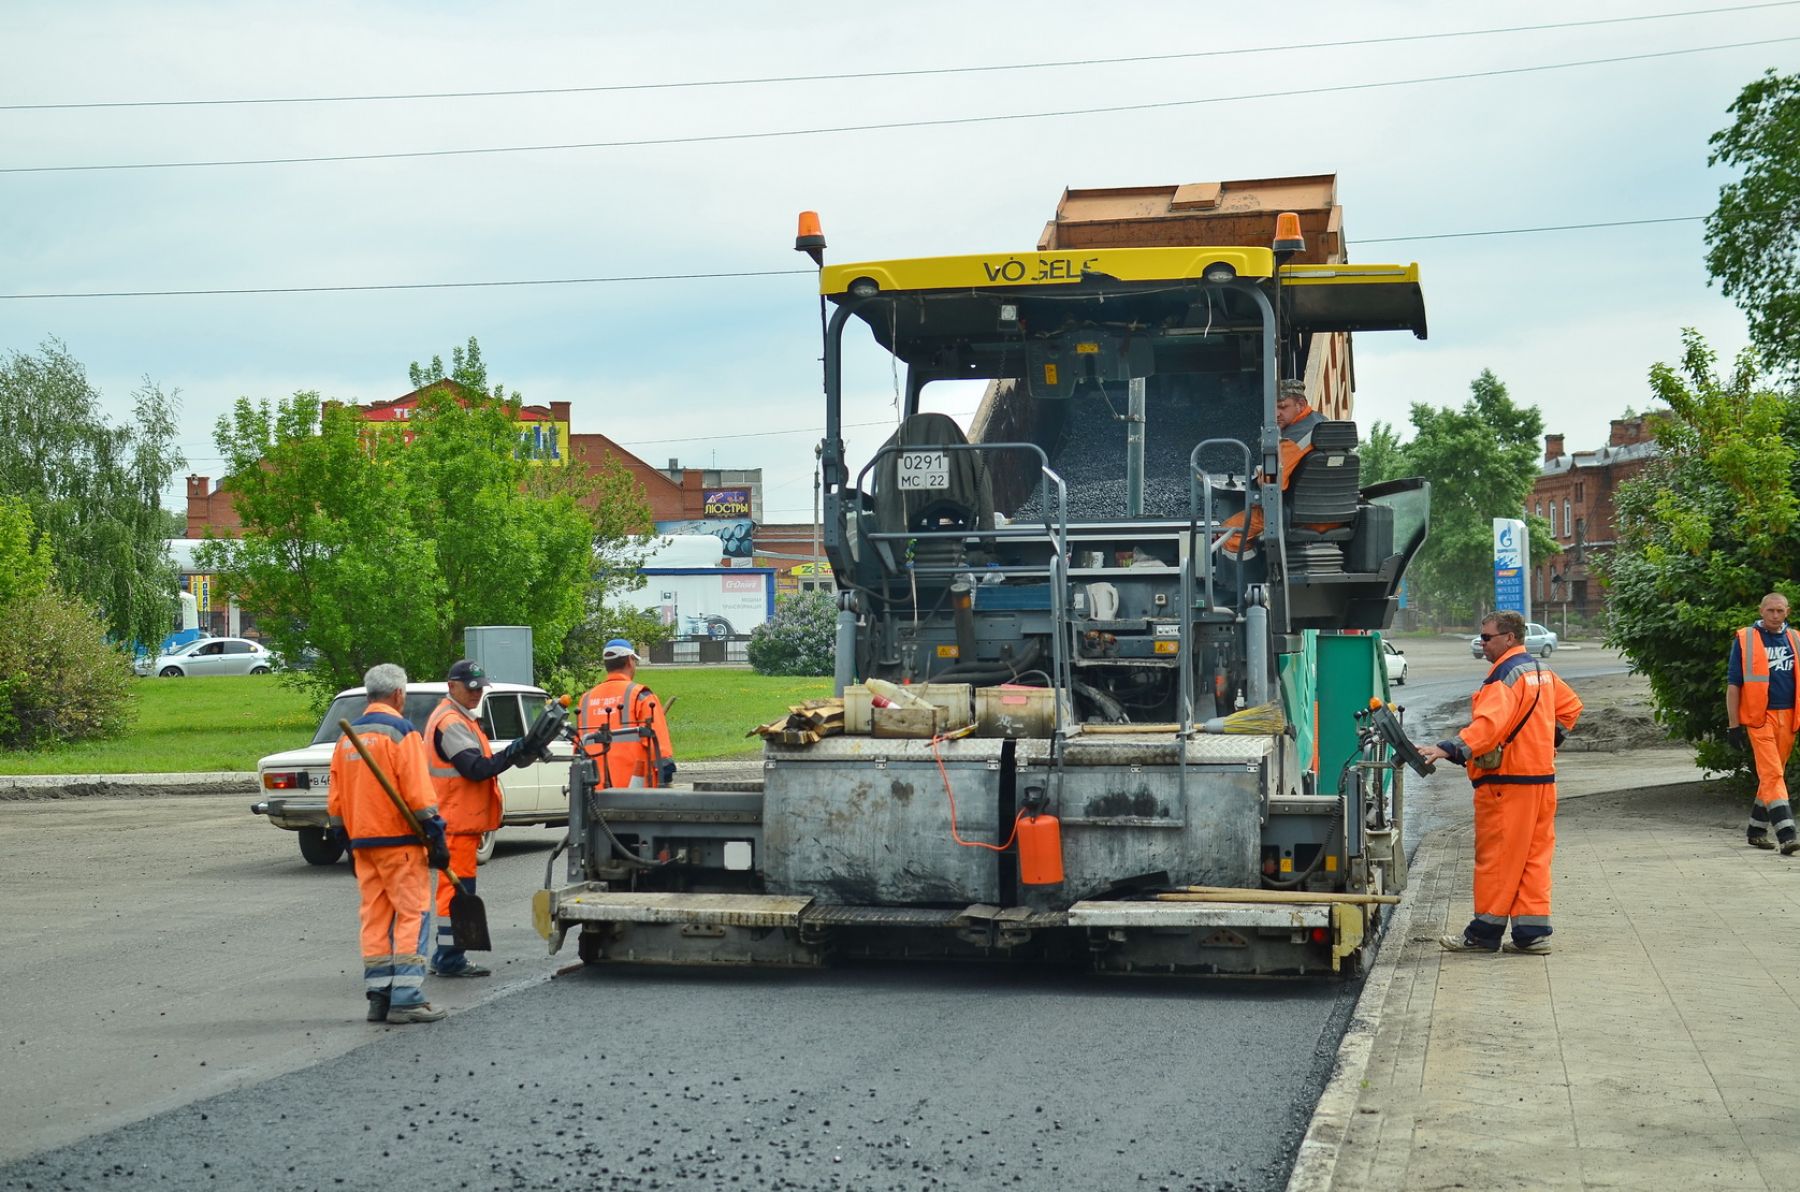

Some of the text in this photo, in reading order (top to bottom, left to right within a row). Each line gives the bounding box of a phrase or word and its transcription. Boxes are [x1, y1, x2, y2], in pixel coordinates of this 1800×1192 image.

[903, 454, 942, 470] 0291
[929, 474, 944, 486] 22
[704, 503, 749, 514] ЛЮСТРЫ
